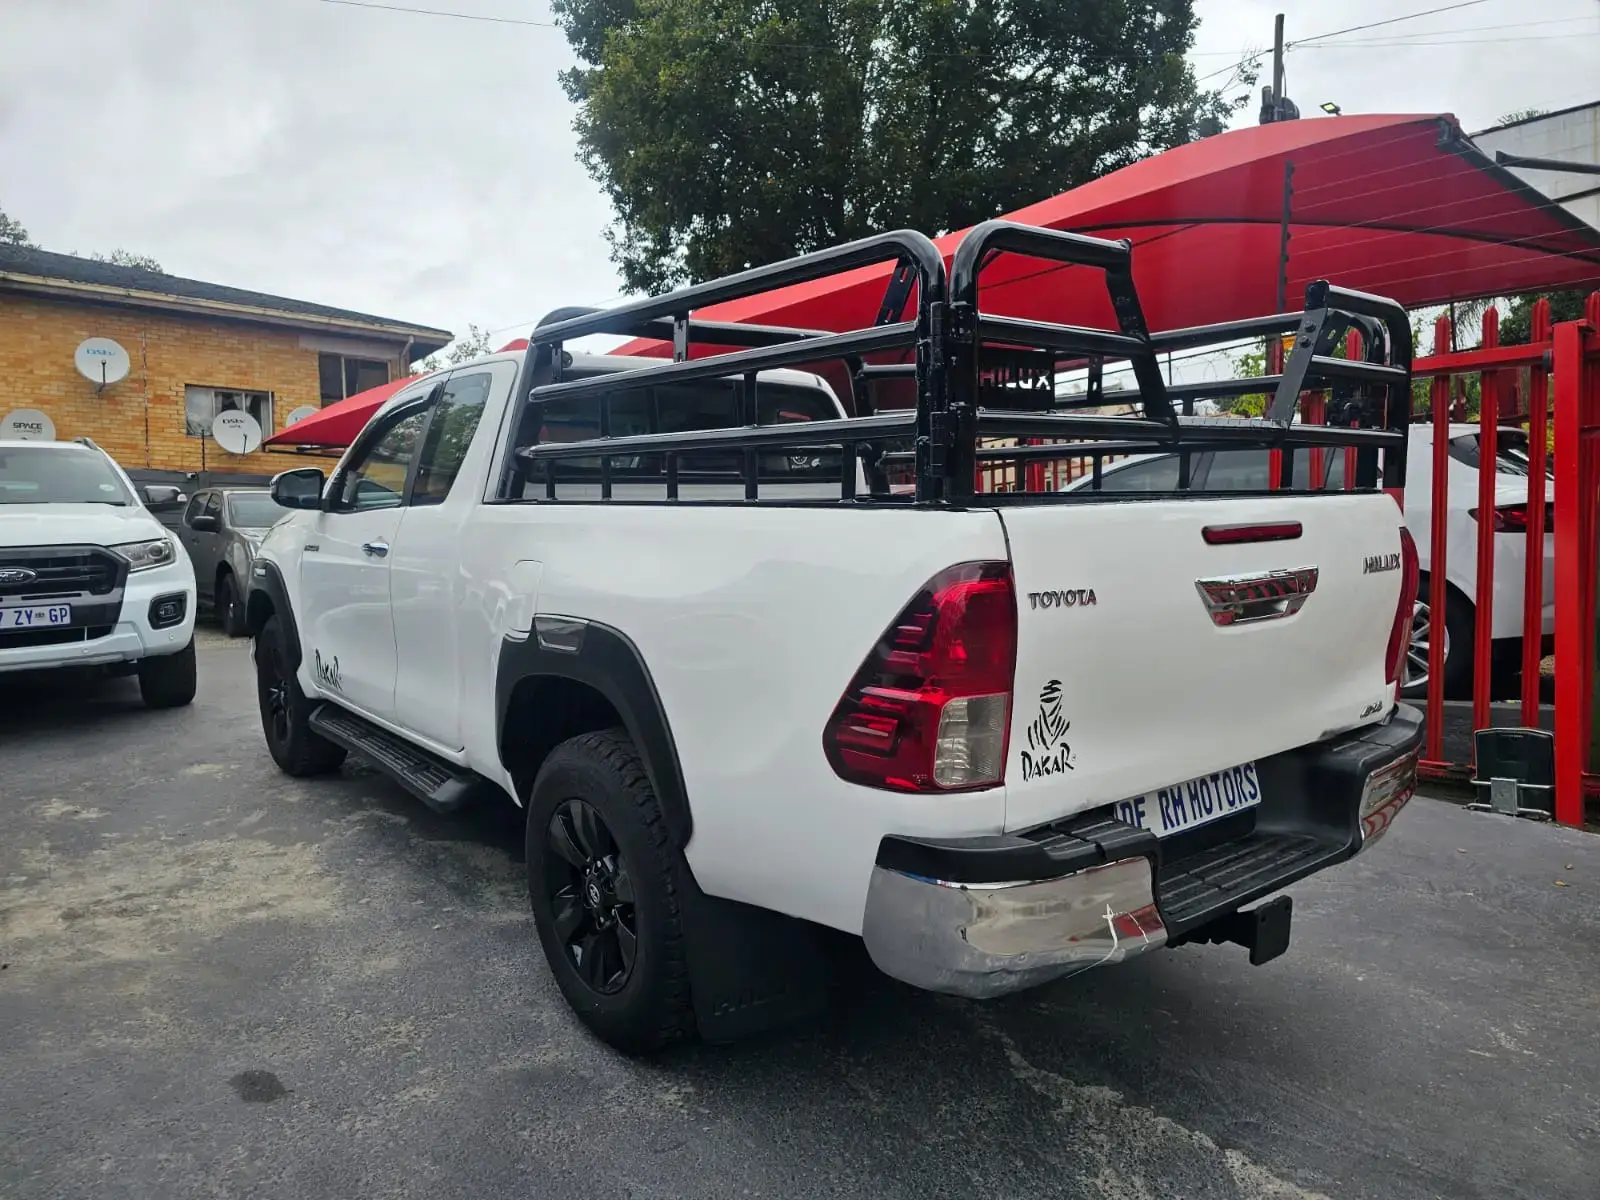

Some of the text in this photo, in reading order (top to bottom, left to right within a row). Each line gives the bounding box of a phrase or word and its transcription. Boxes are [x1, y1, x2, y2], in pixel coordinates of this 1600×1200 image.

[1027, 588, 1097, 610] TOYOTA
[14, 609, 33, 625] ZY
[49, 607, 68, 623] GP
[1021, 742, 1074, 782] DAKAR
[1157, 786, 1188, 831] RM
[1186, 762, 1258, 820] MOTORS
